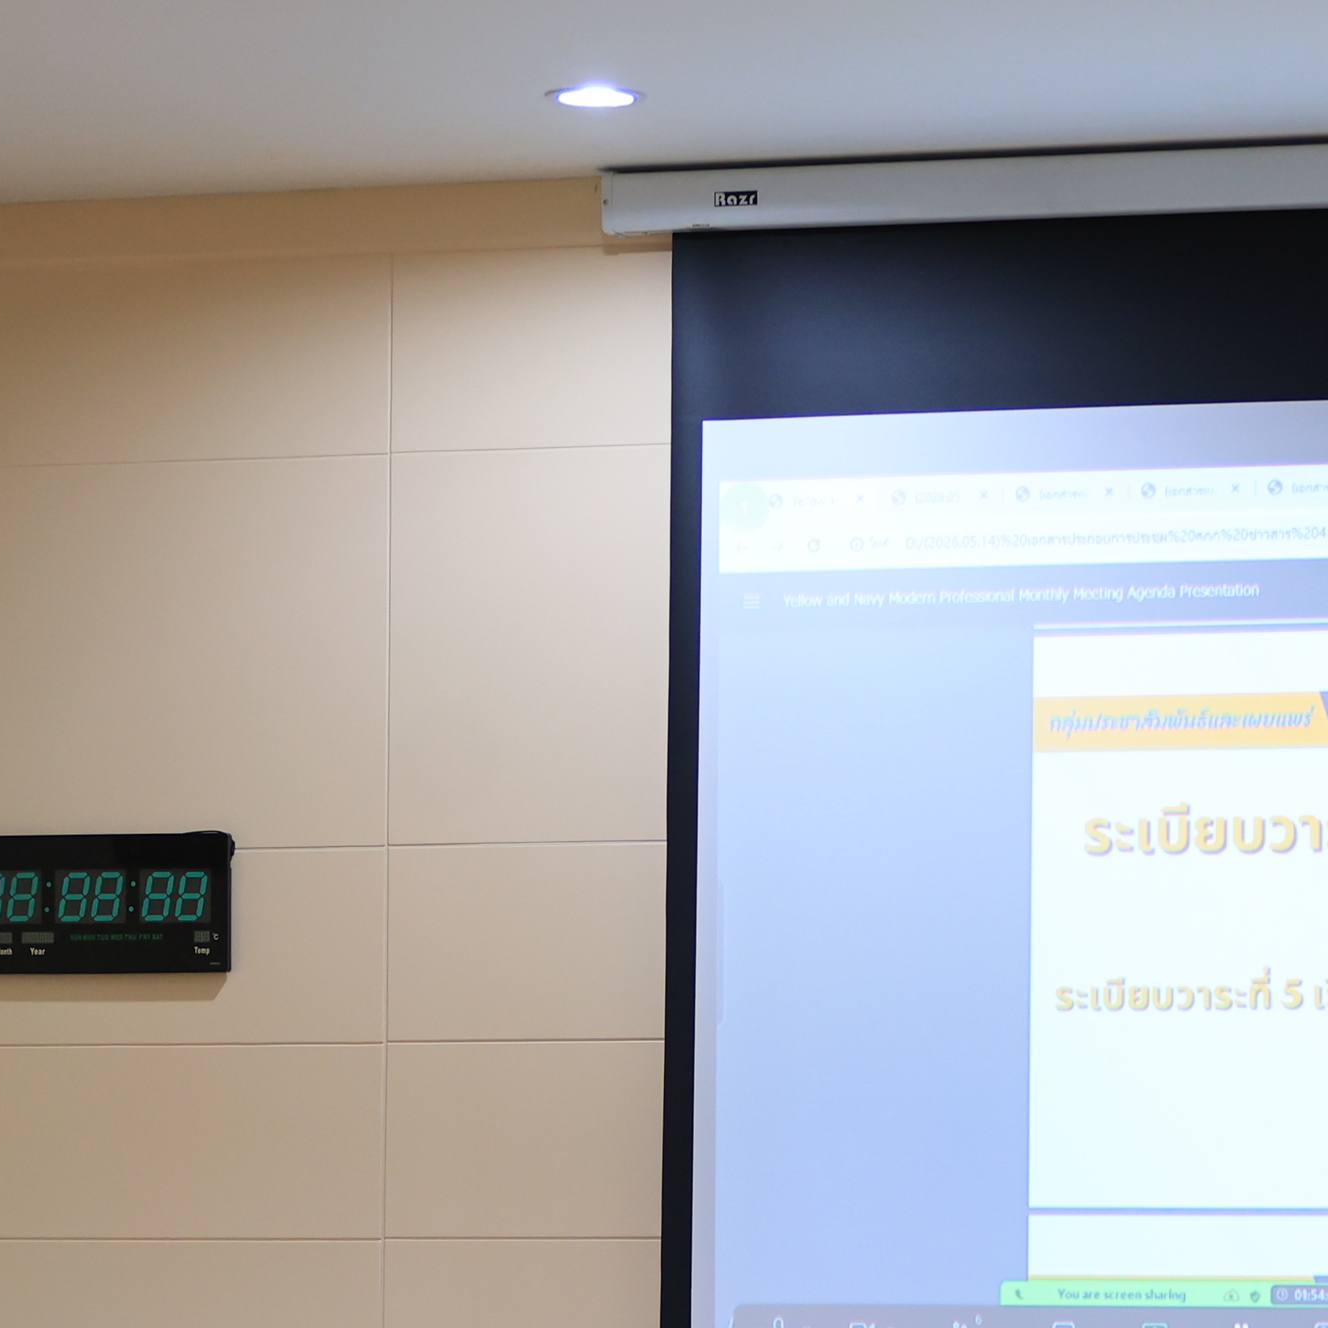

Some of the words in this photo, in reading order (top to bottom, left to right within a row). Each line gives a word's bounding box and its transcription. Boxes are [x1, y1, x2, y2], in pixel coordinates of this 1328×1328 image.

[715, 192, 757, 207] Razr
[783, 593, 823, 608] Yellow
[826, 592, 850, 606] and
[854, 591, 885, 609] Navy
[888, 590, 936, 606] Modern
[940, 588, 1015, 605] Professional
[1019, 587, 1069, 604] Monthly
[1073, 585, 1124, 604] Meeting
[1127, 583, 1176, 600] Agenda
[1180, 581, 1260, 599] Presentation
[1048, 706, 1315, 738] กลุ่มประชาสัมพันธ์และเผยแพร่
[30, 947, 46, 956] Year
[194, 946, 210, 956] Temp
[1054, 967, 1272, 1011] ระเบียบวาระที่
[1281, 978, 1304, 1010] 5
[1057, 1288, 1079, 1301] You
[1082, 1290, 1101, 1302] are
[1103, 1290, 1138, 1302] screen
[1140, 1288, 1187, 1304] sharing
